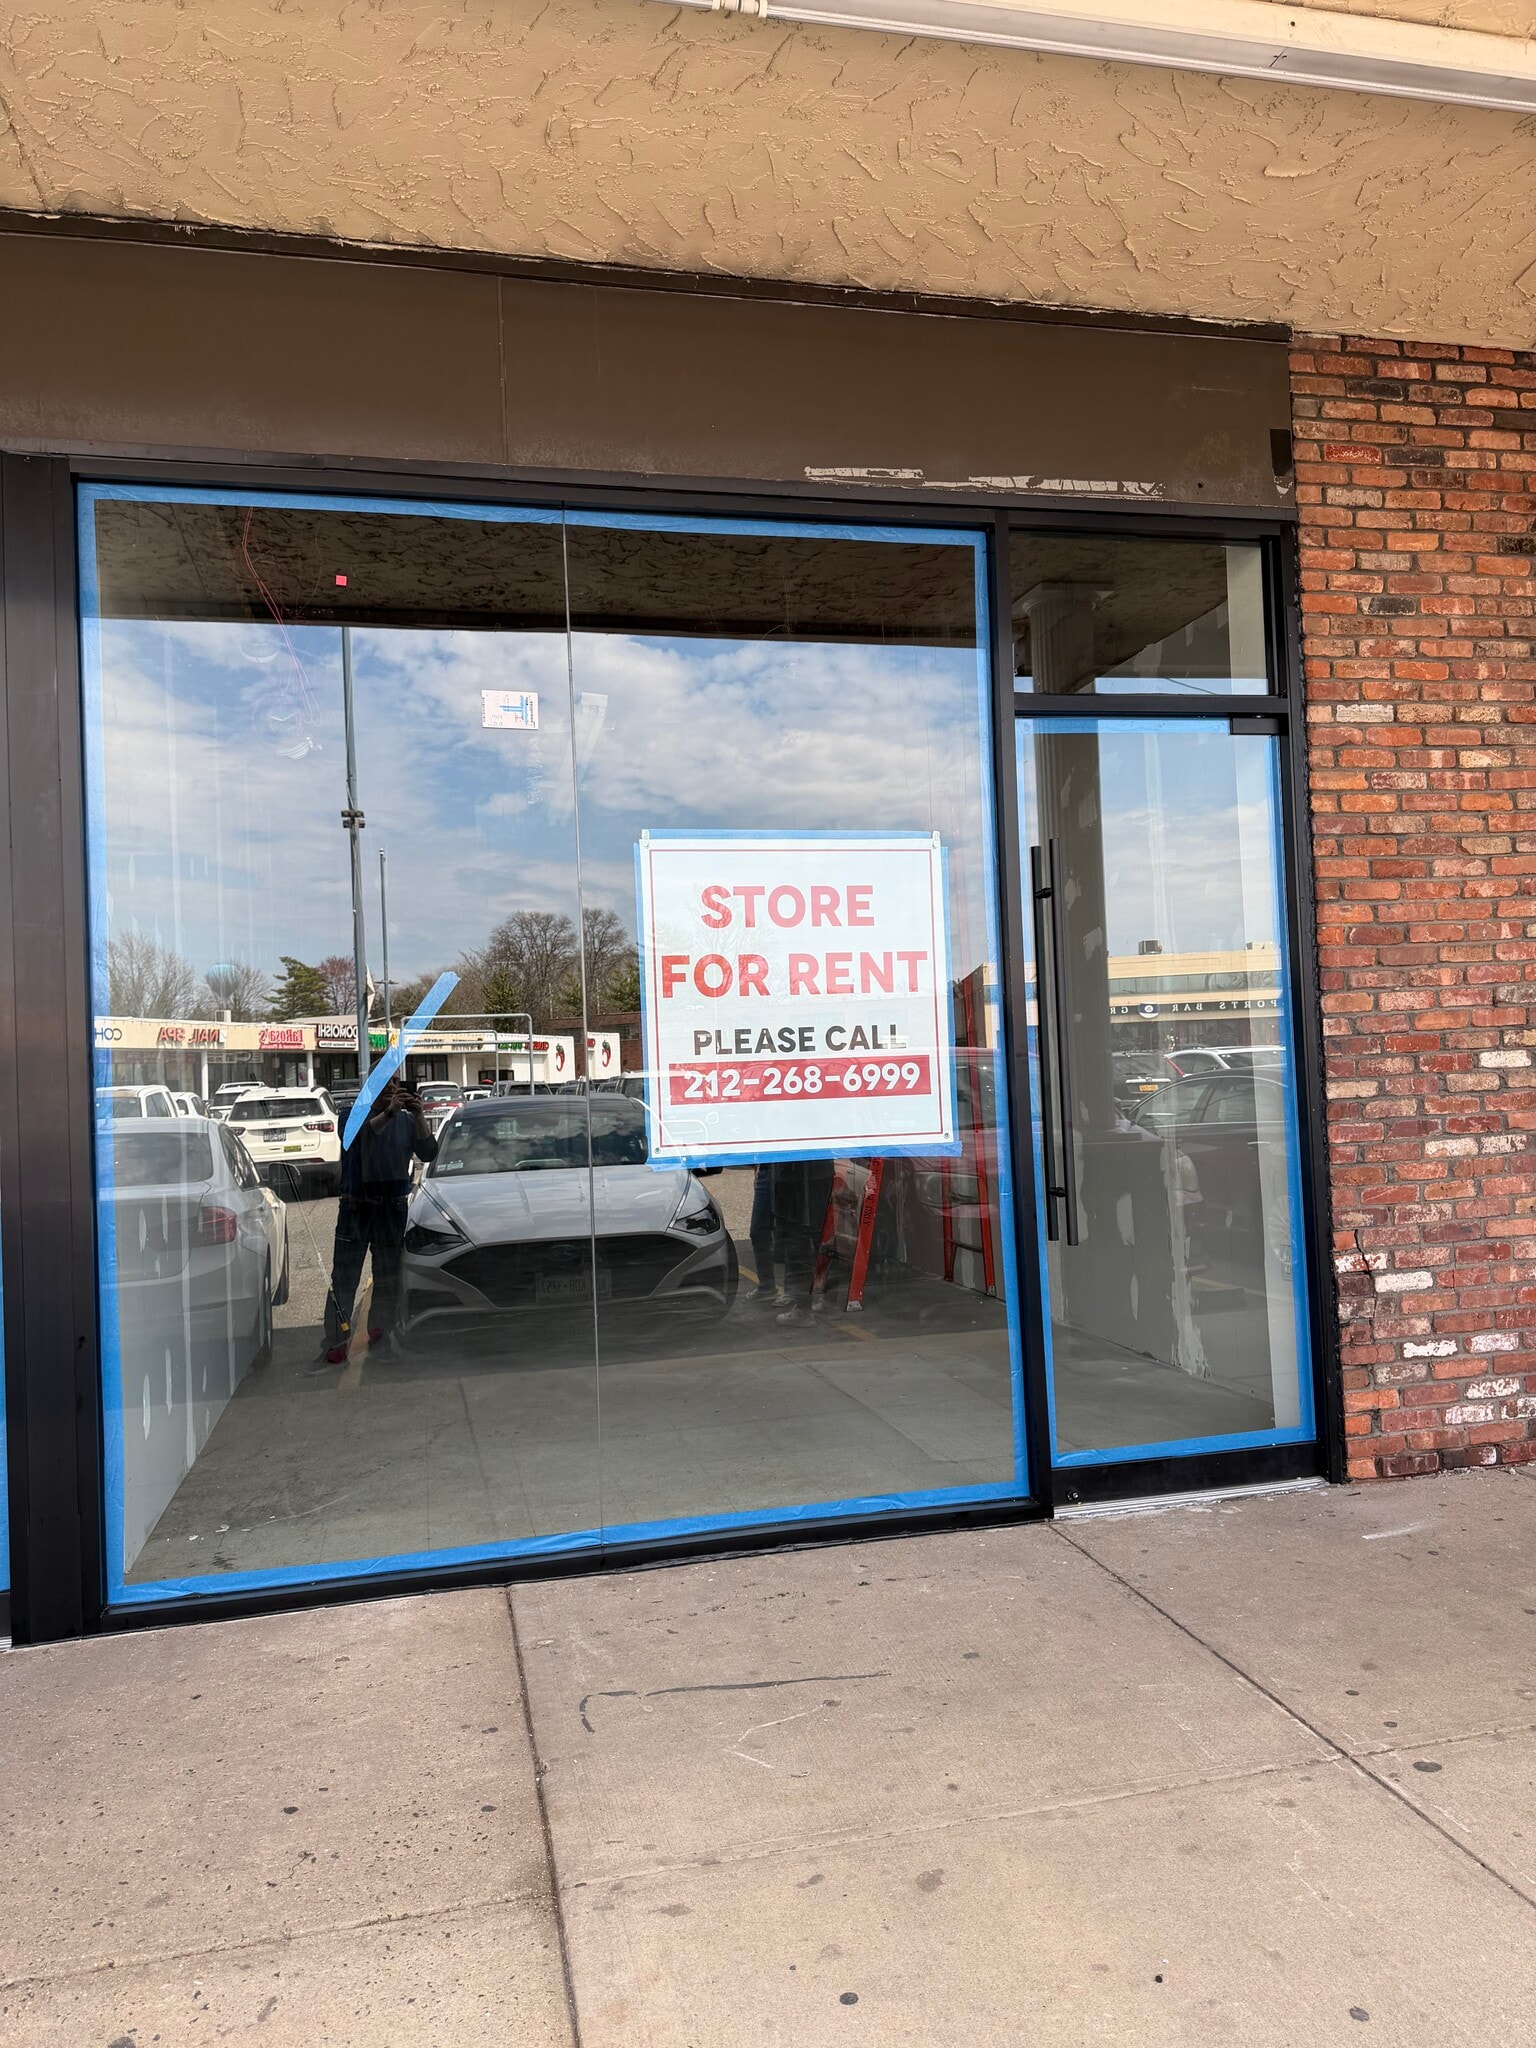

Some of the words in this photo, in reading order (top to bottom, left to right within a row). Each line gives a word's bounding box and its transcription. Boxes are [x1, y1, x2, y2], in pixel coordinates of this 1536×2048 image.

[701, 885, 875, 928] STORE
[661, 953, 771, 998] FOR
[788, 951, 928, 996] RENT
[693, 1026, 816, 1056] PLEASE
[825, 1024, 907, 1050] CALL
[684, 1062, 921, 1098] 212-268-6999
